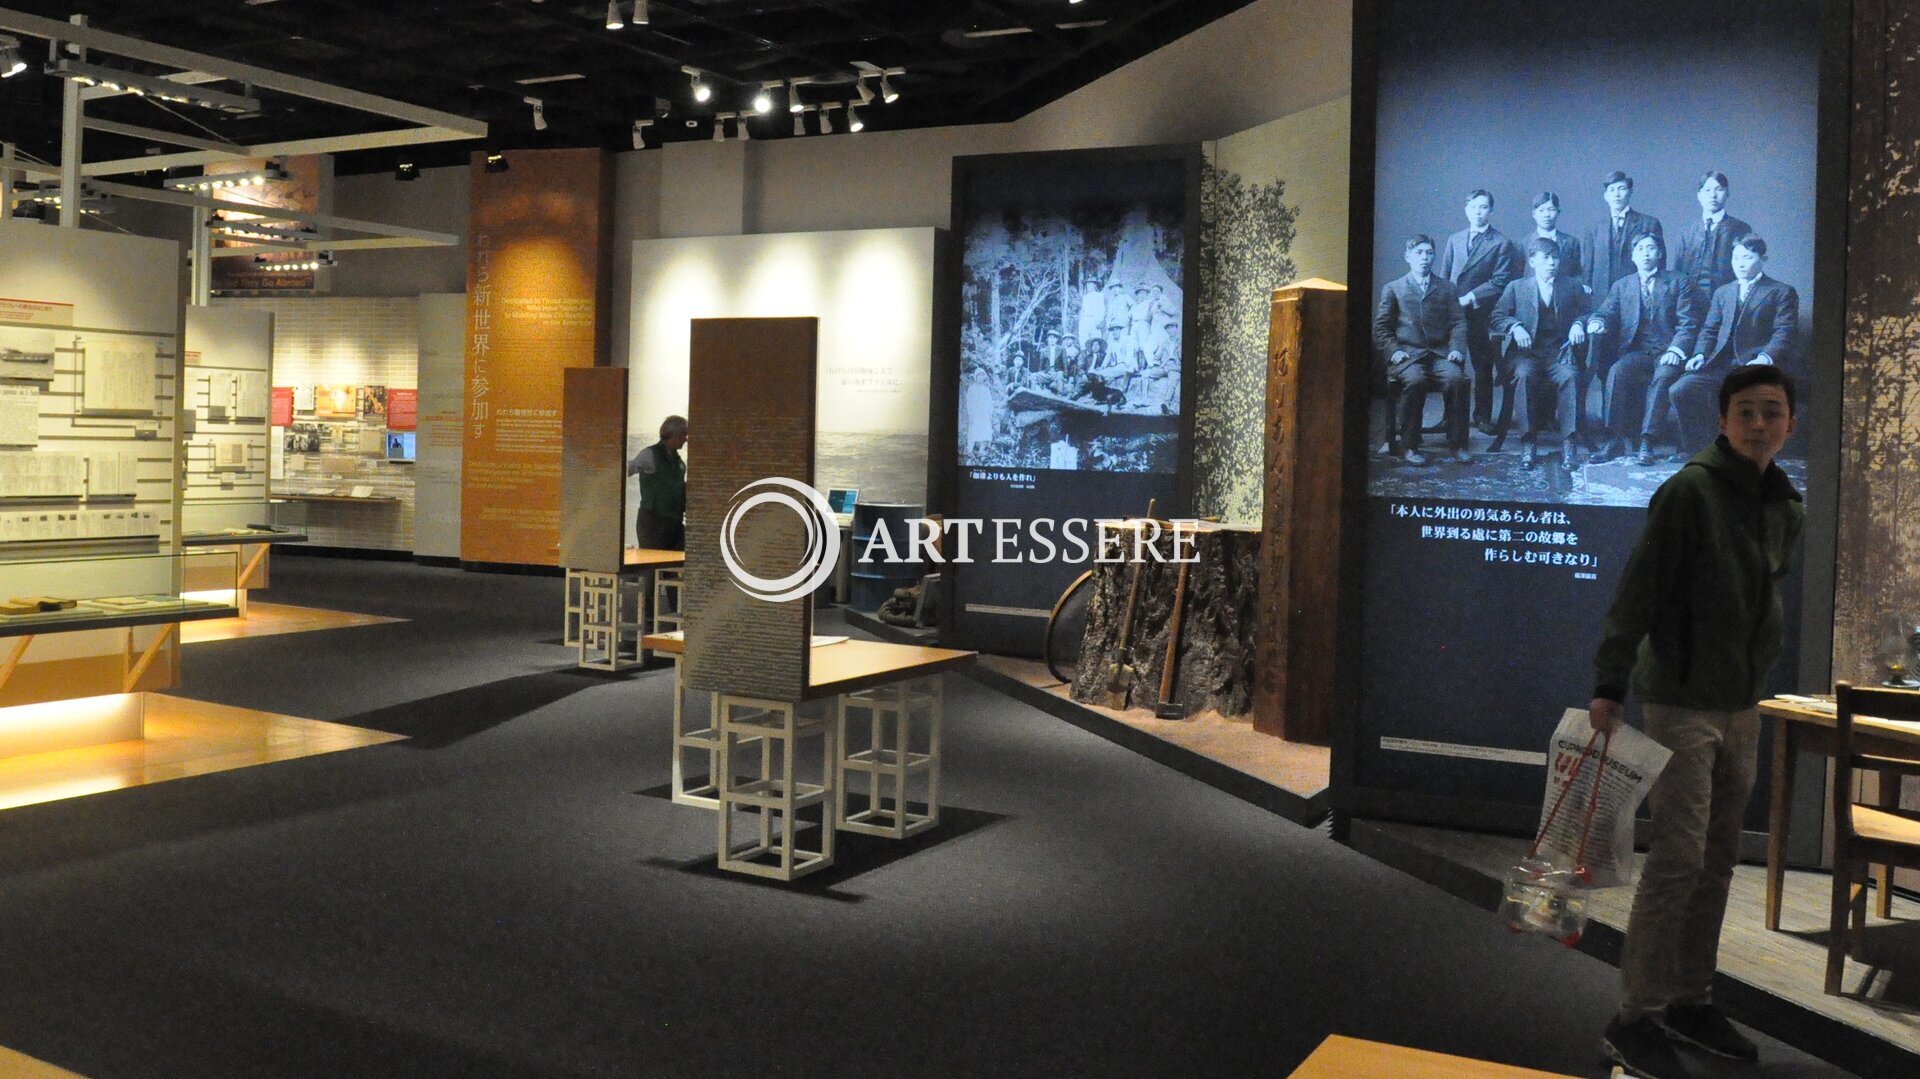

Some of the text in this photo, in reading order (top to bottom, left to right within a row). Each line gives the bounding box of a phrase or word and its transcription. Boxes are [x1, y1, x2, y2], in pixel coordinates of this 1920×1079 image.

[471, 234, 490, 439] われら新世界に参加す
[1390, 504, 1572, 525] 「本人に外出の勇気あらん者は、
[1484, 549, 1598, 567] 作らしむ可きなり」
